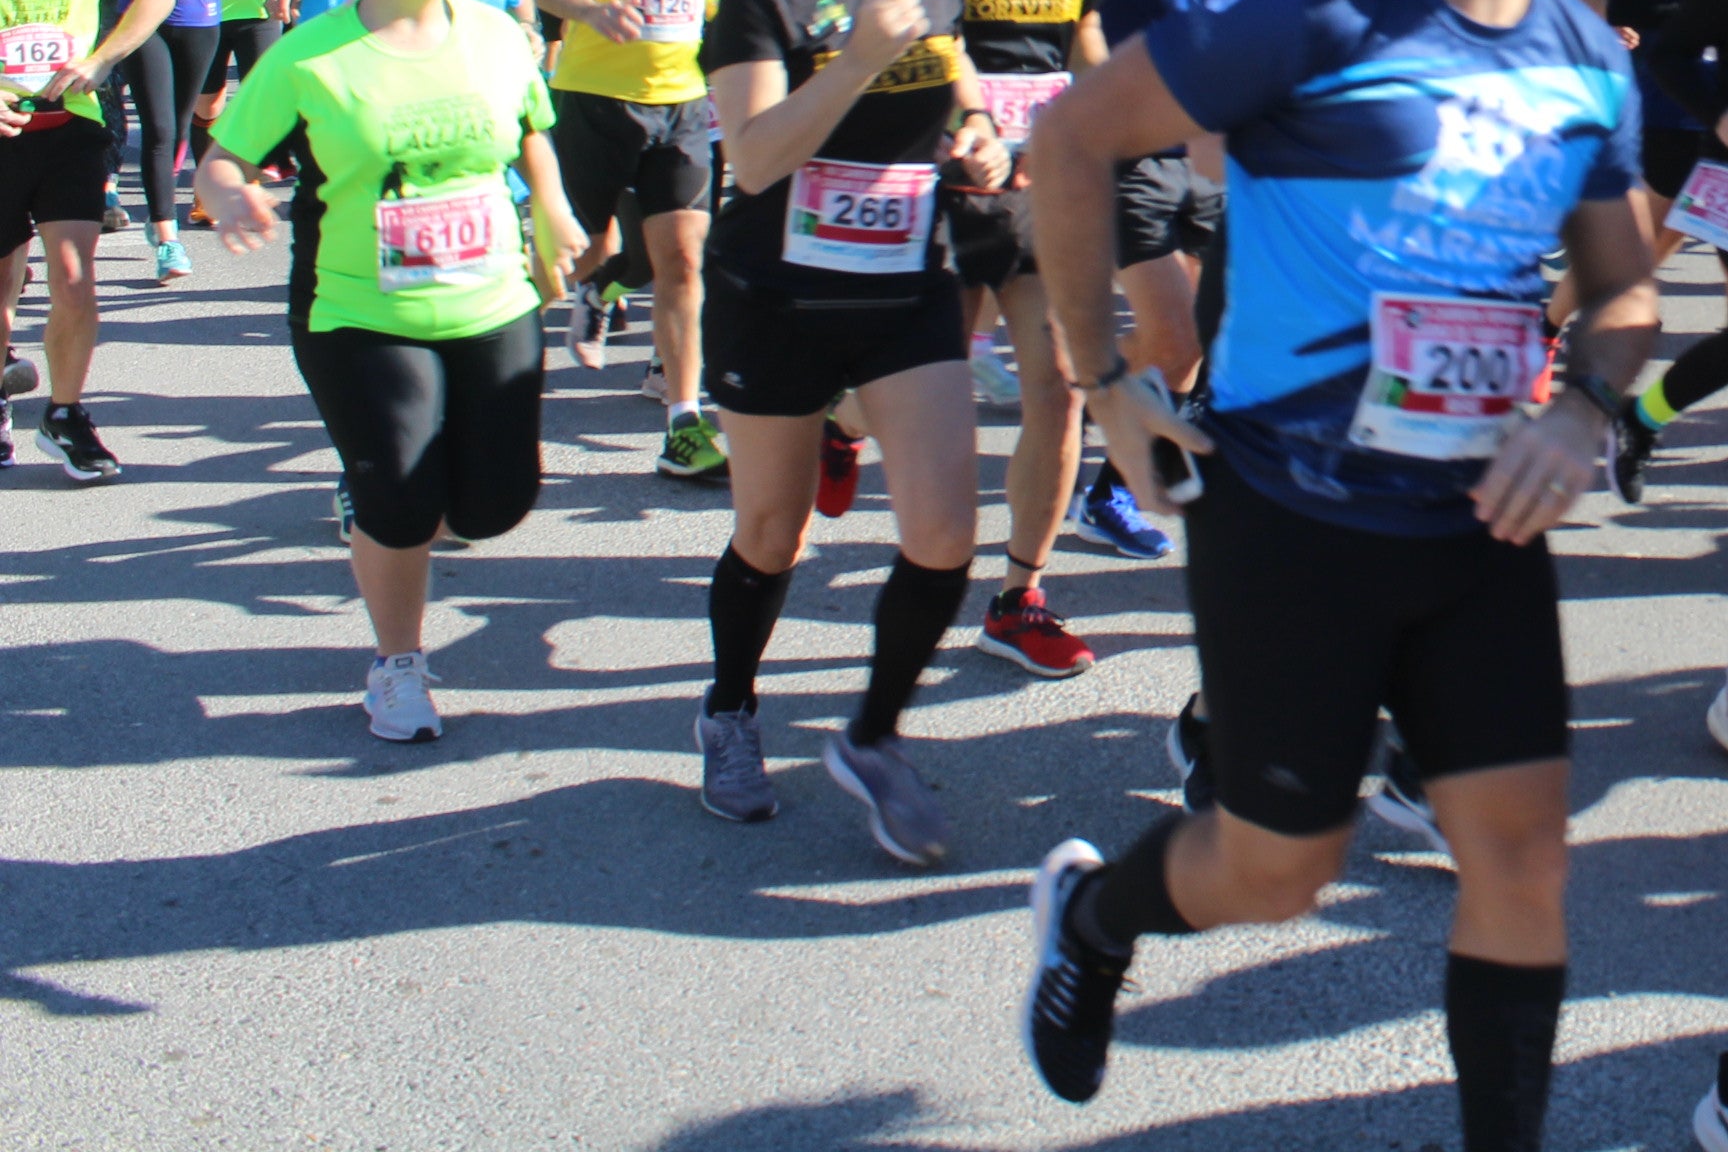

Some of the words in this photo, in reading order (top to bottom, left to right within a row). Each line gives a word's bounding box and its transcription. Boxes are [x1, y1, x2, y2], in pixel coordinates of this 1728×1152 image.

[965, 0, 1065, 21] FOREVER
[15, 41, 60, 62] 162
[834, 194, 902, 228] 266
[416, 218, 476, 254] 610
[1428, 343, 1510, 392] 200
